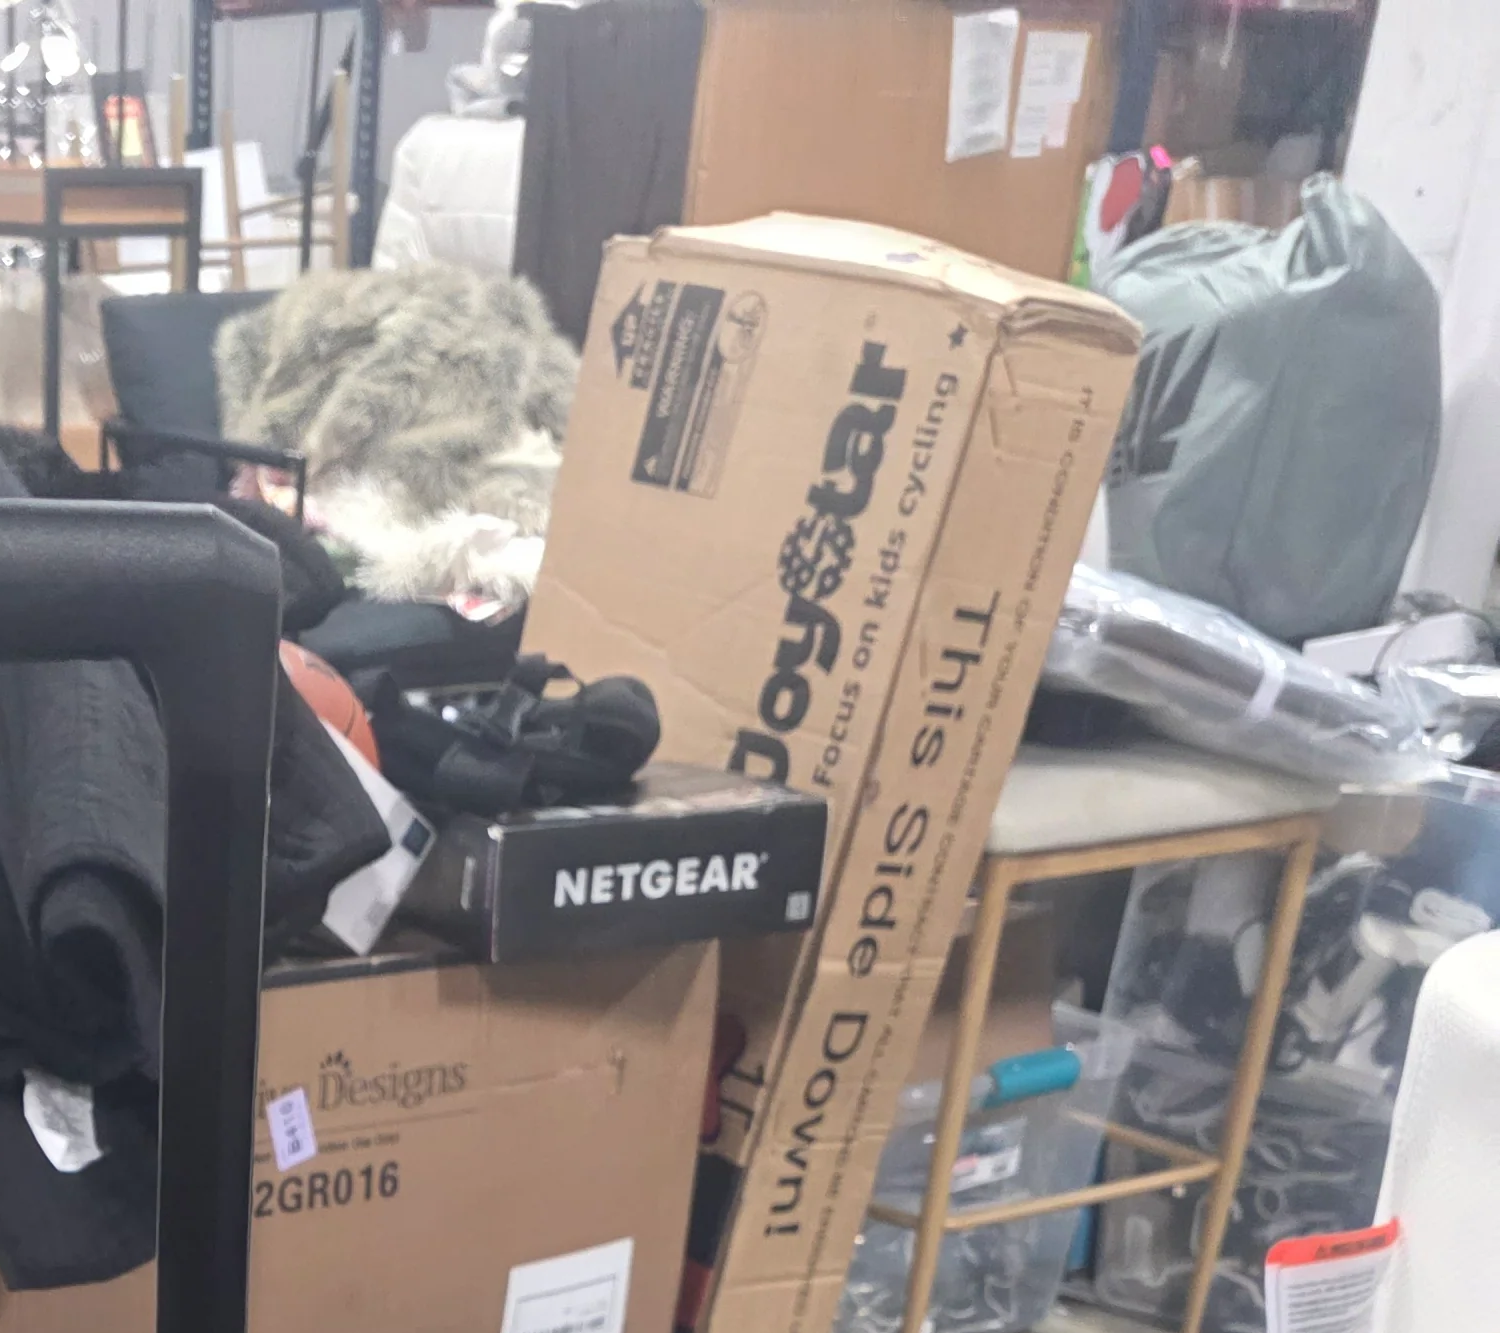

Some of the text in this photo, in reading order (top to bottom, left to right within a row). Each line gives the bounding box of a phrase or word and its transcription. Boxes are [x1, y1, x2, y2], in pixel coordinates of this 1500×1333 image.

[656, 308, 698, 419] WARNING
[812, 371, 959, 789] Focus on kids cycling
[910, 588, 1003, 768] This
[553, 852, 761, 908] NETGEAR
[848, 801, 930, 978] Side
[319, 1061, 469, 1110] Designs
[765, 1011, 869, 1239] Down!
[254, 1160, 400, 1218] 2GR016
